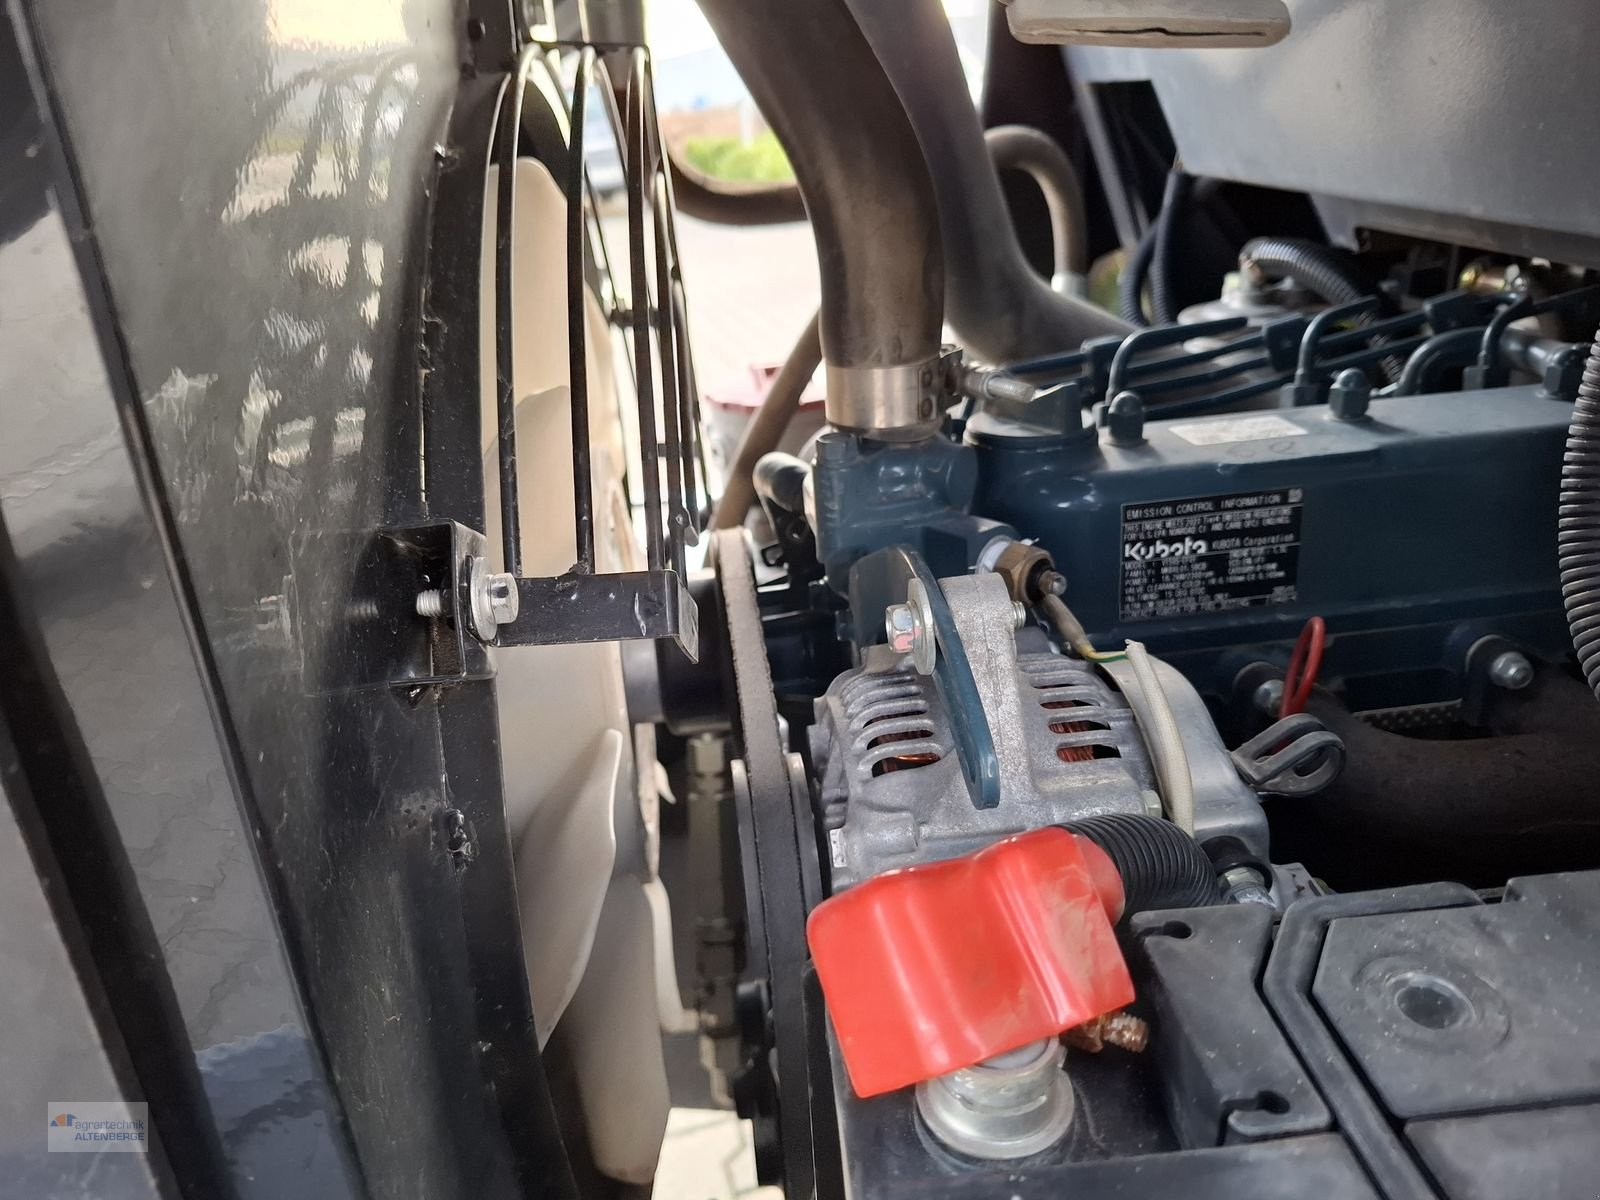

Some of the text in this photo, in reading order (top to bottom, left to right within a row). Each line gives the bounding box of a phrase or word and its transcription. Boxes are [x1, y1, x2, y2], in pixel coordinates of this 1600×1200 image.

[1126, 494, 1280, 520] EMISSION CONTROL INFORMATION
[1125, 536, 1207, 560] Kubota
[1212, 537, 1240, 550] KUBOTA
